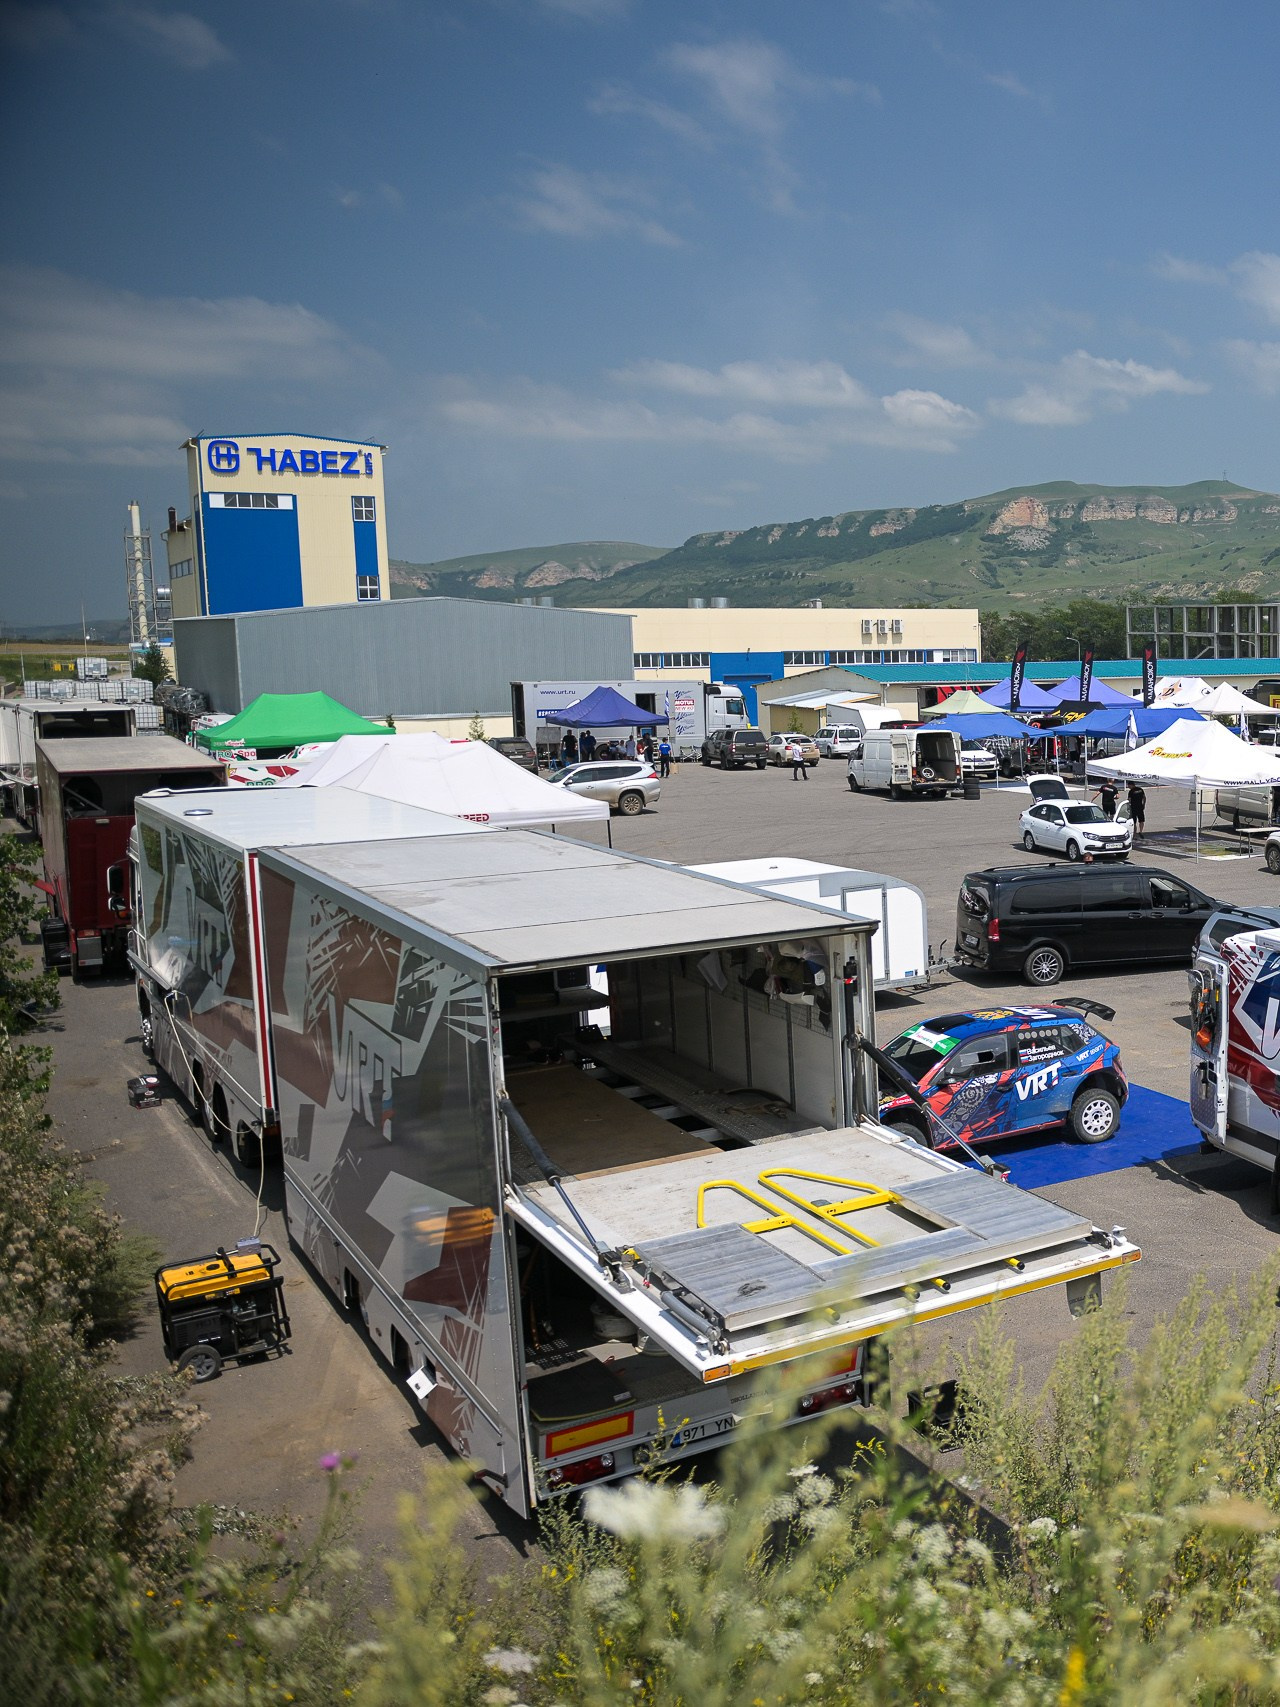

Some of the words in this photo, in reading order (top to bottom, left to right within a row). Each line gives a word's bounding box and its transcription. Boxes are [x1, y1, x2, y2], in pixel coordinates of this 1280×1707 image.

[246, 448, 360, 475] HABEZ
[327, 988, 402, 1142] VRT
[1076, 1050, 1089, 1062] VRT
[1015, 1061, 1062, 1101] VRT
[683, 1425, 706, 1441] 971
